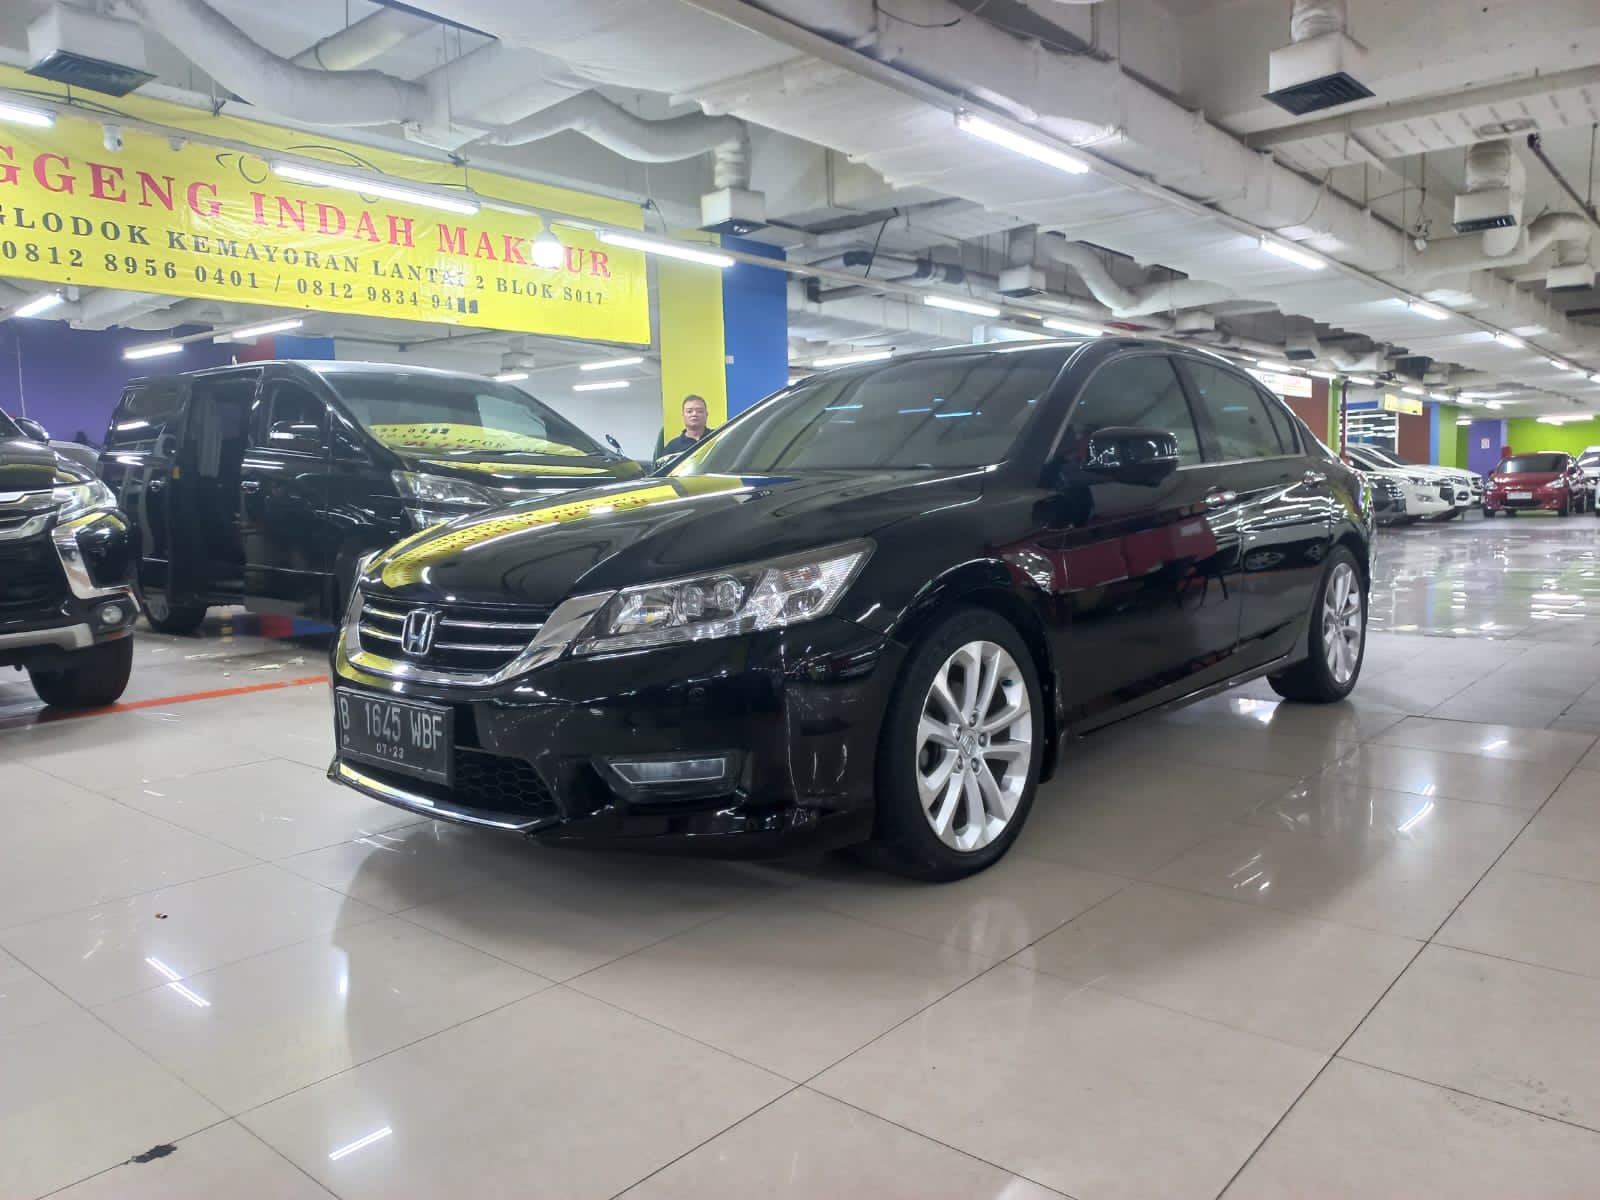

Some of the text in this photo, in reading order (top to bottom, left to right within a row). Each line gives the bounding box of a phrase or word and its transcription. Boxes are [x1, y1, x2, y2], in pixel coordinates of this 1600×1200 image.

[167, 230, 359, 273] KEMAYORAN
[373, 260, 464, 288] LANTAI
[476, 275, 484, 290] 2
[496, 277, 553, 299] BLOK
[250, 191, 416, 248] INDAH
[437, 223, 612, 278] MAKUR
[2, 240, 83, 267] 0812
[104, 253, 177, 280] 8956
[194, 265, 259, 290] 0401
[297, 278, 353, 300] 0812
[367, 286, 419, 307] 9834
[341, 697, 442, 751] B 1645 WBF
